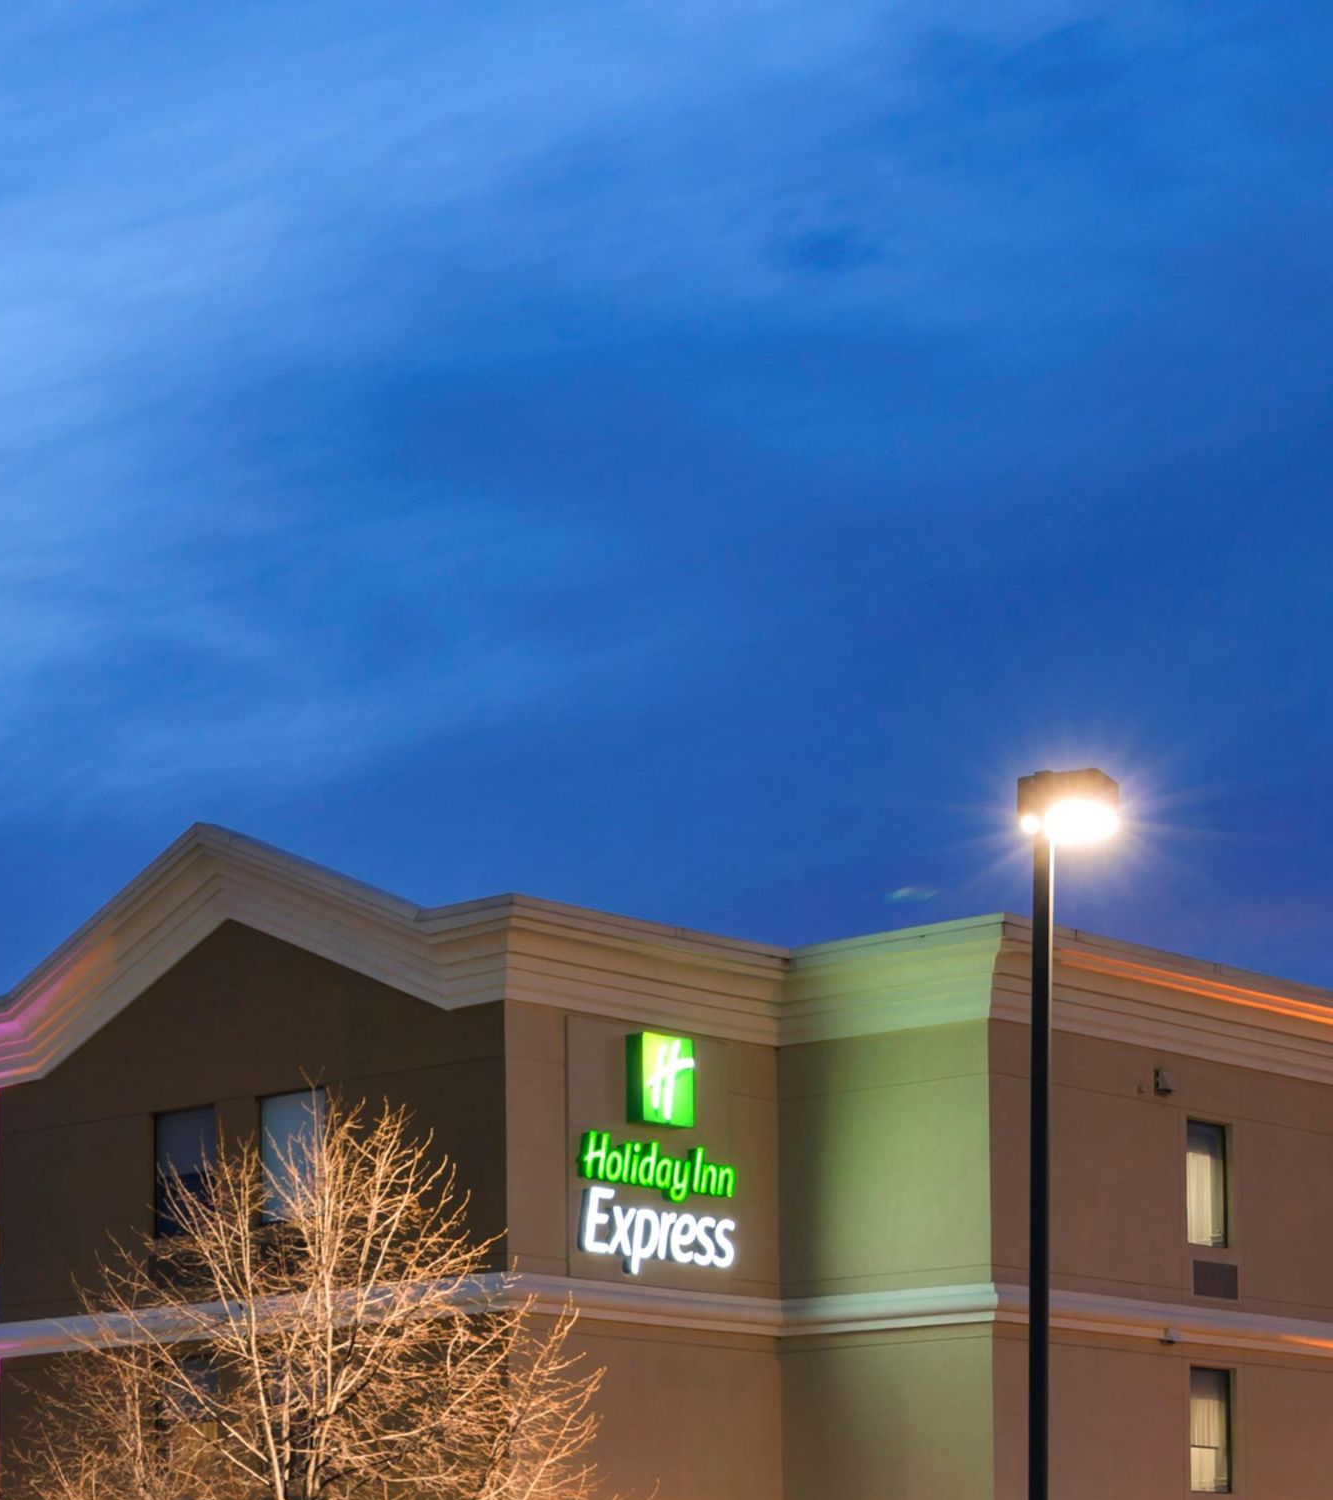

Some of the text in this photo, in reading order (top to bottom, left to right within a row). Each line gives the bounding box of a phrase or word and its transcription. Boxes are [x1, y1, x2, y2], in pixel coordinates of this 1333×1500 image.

[583, 1131, 735, 1202] Holiday Inn
[584, 1186, 736, 1274] Express
